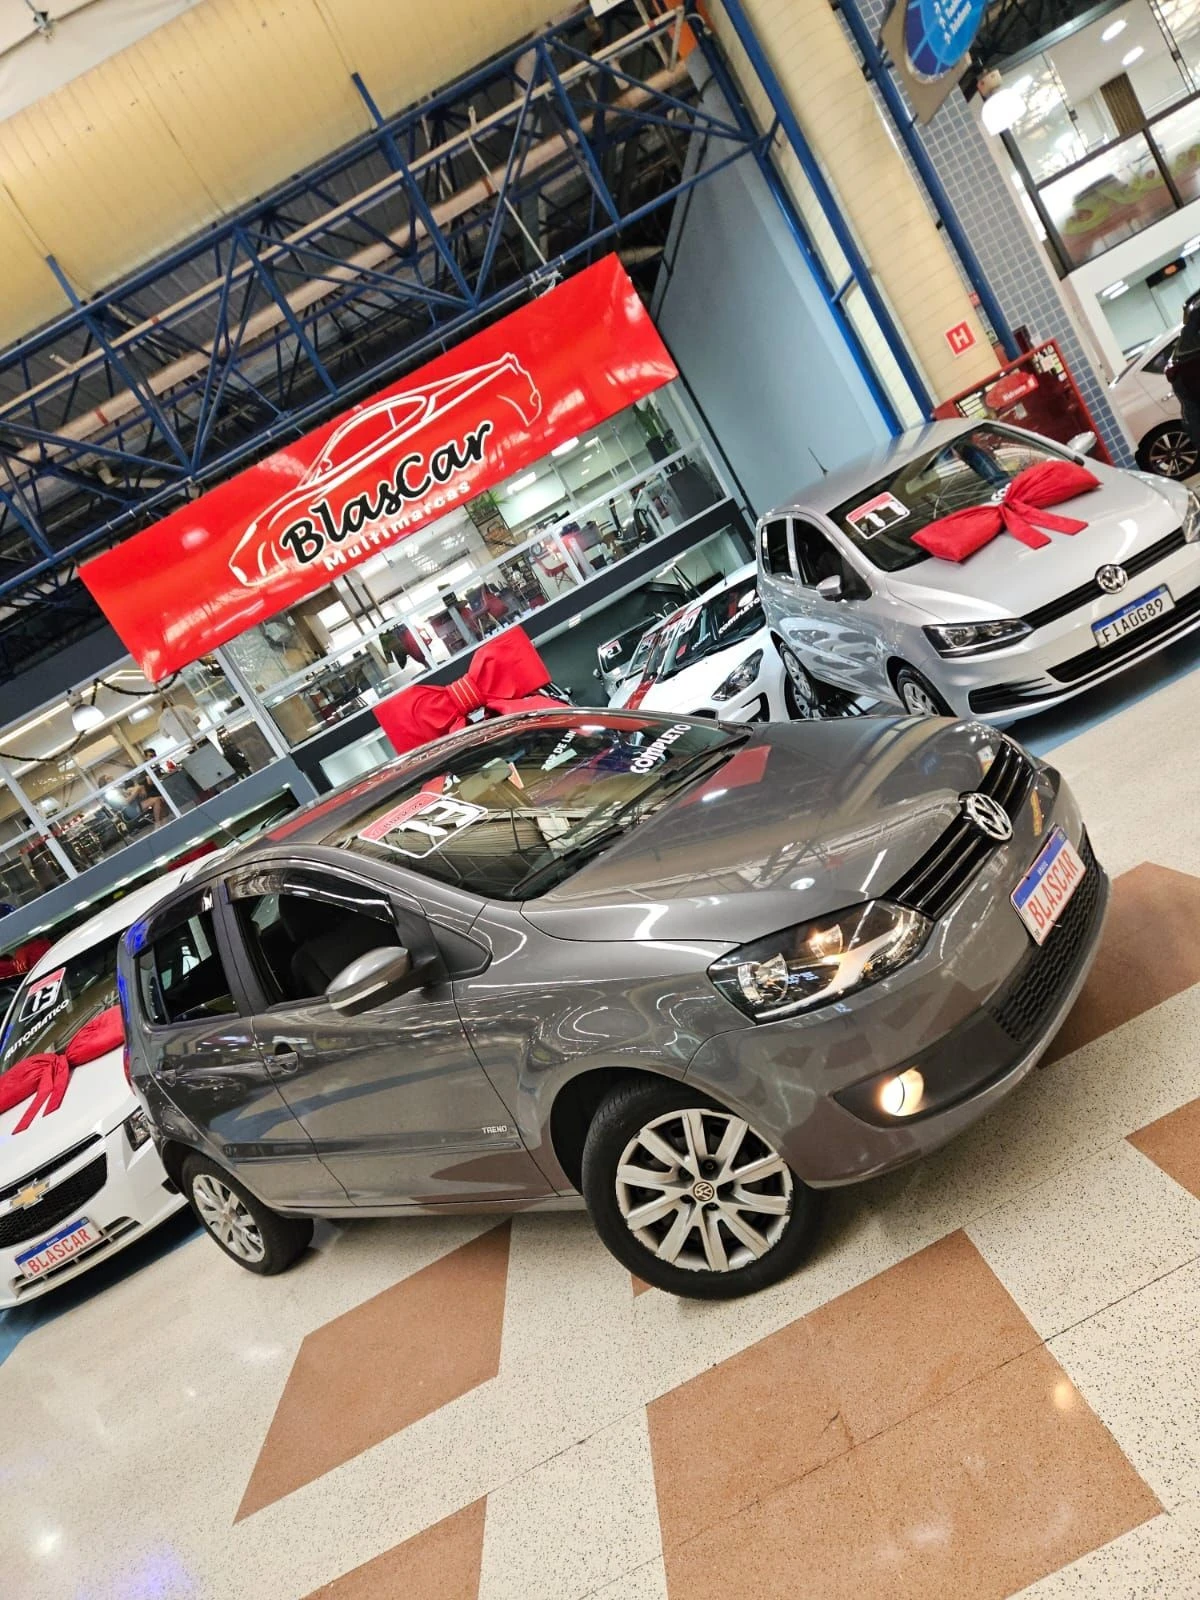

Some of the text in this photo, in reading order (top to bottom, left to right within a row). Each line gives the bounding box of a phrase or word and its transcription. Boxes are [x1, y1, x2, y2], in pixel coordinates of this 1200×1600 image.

[280, 421, 493, 565] BlasCar
[322, 480, 471, 571] Multimarcas
[553, 742, 567, 755] DE
[630, 724, 692, 774] COMPLETO
[1027, 849, 1079, 929] BLASCAR
[31, 980, 60, 1012] 13
[481, 1125, 508, 1134] TREND
[27, 1228, 91, 1273] BLASCAR
